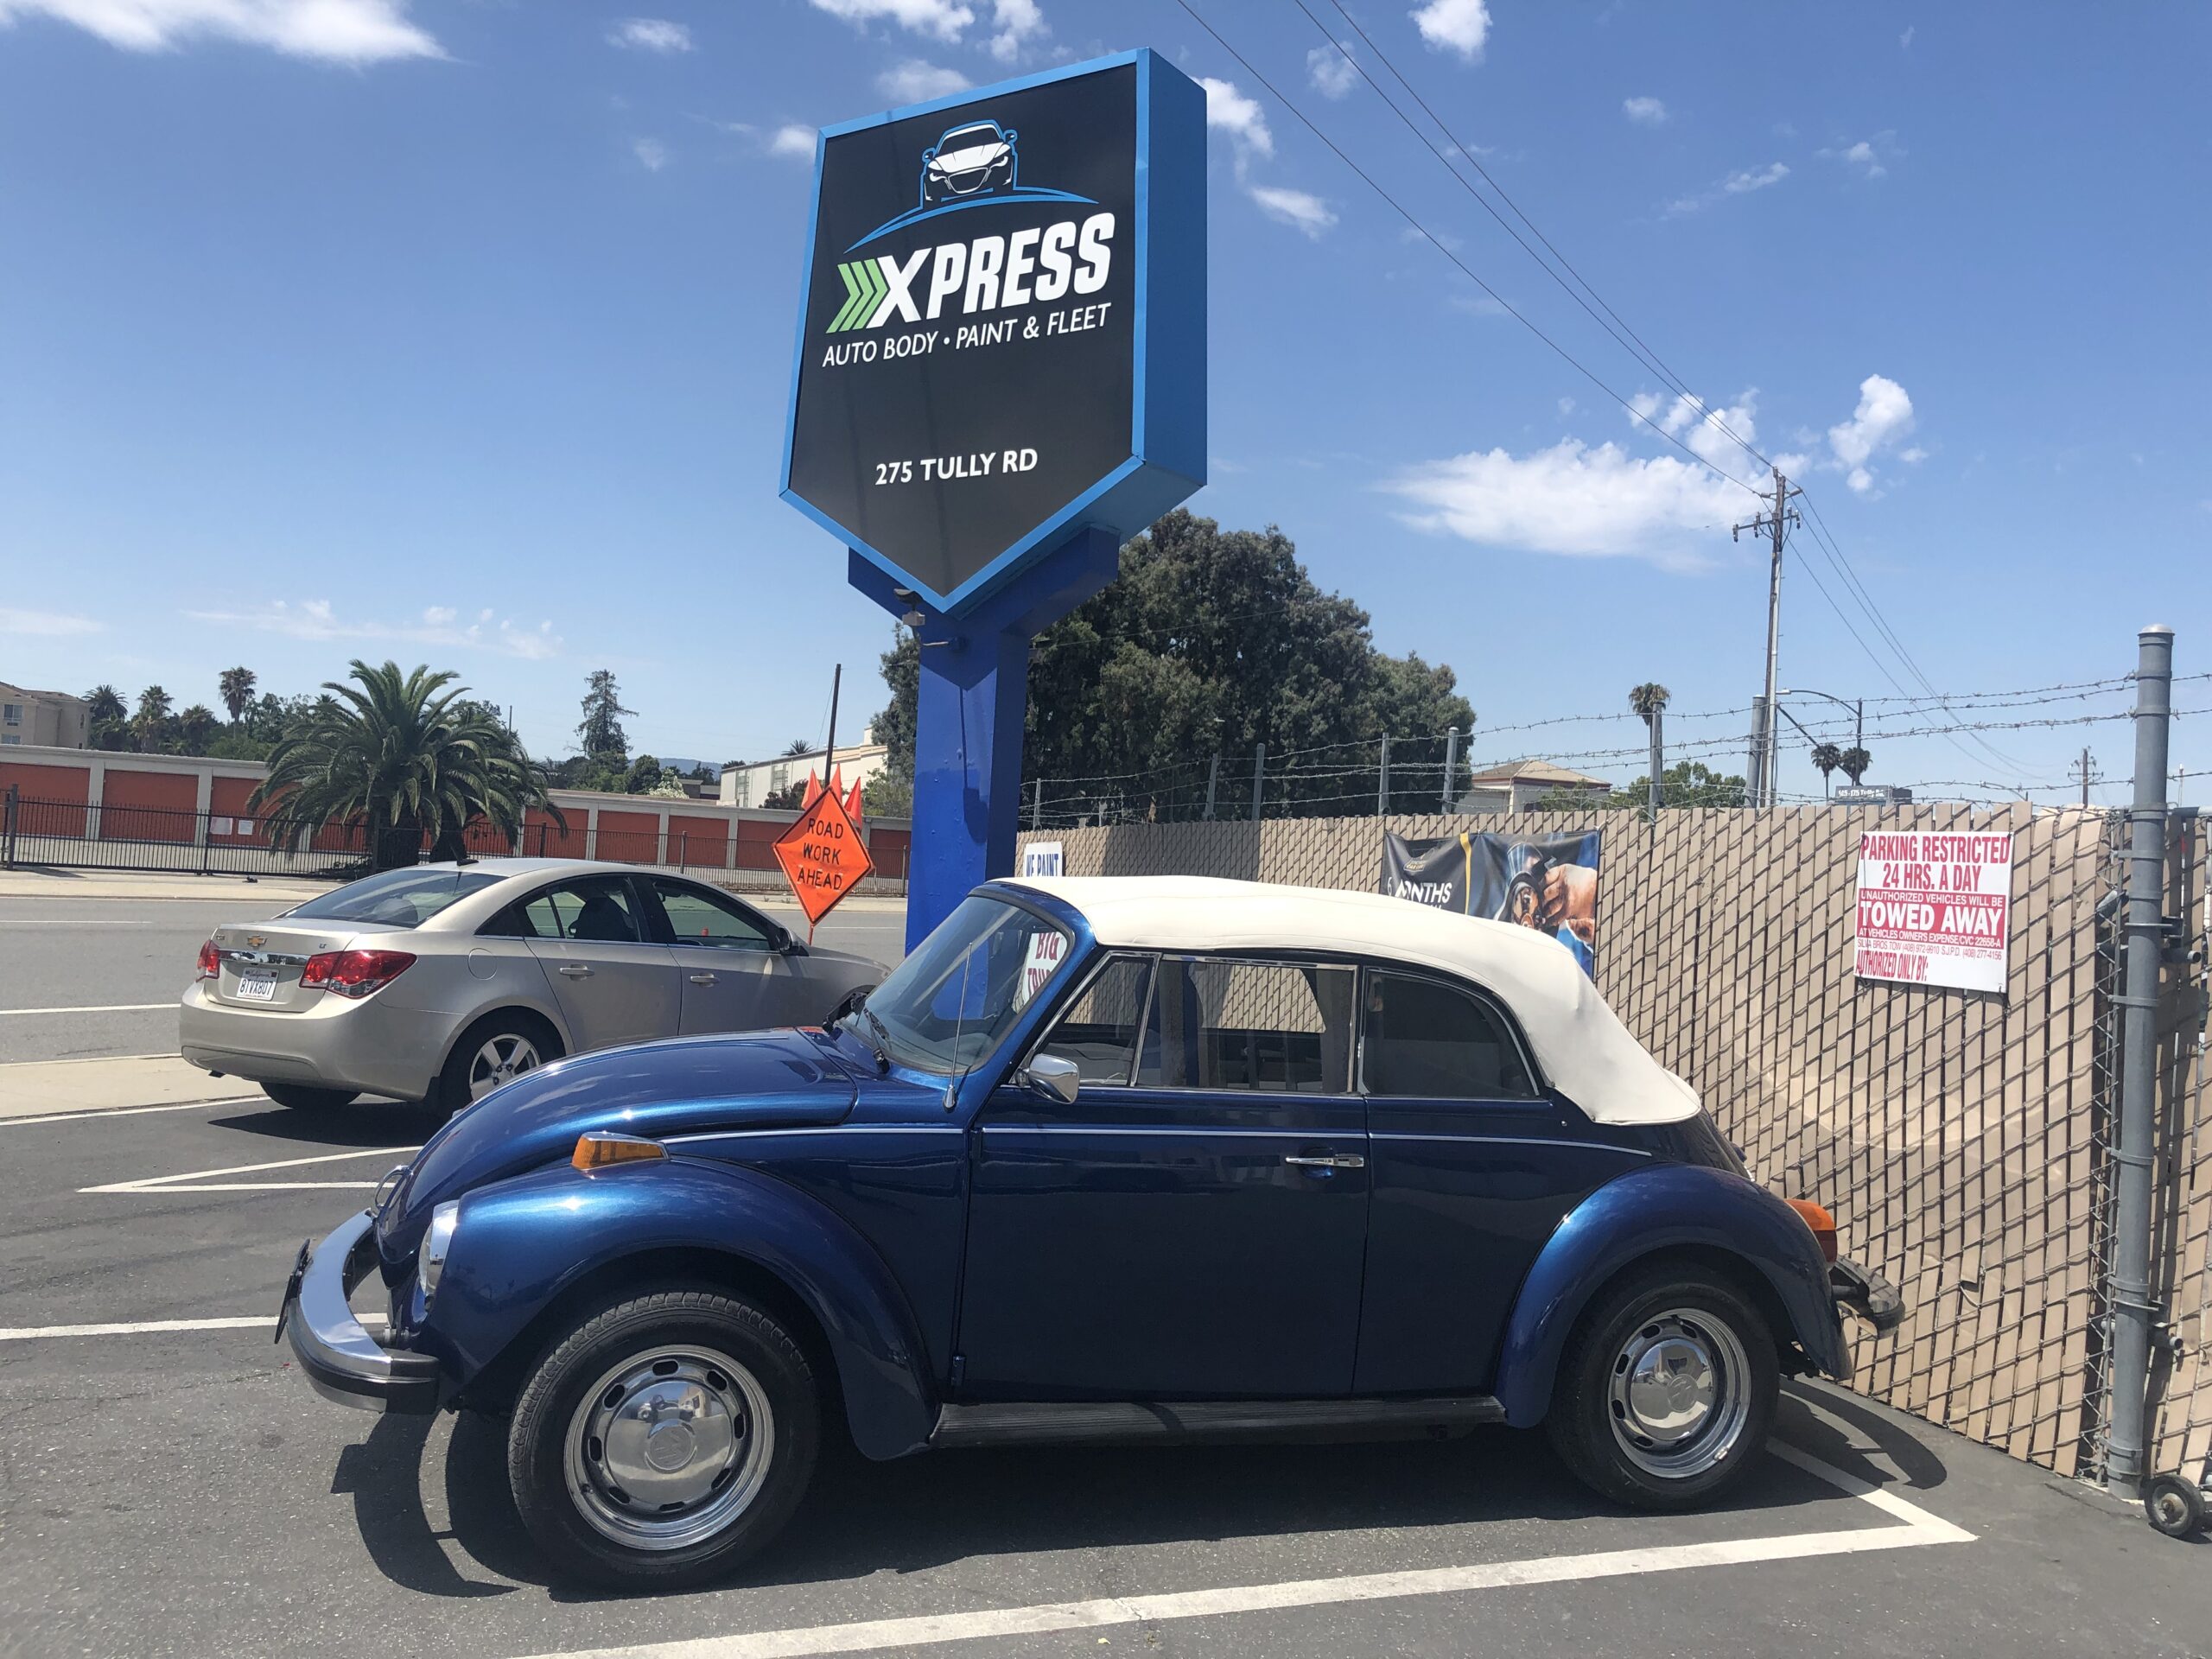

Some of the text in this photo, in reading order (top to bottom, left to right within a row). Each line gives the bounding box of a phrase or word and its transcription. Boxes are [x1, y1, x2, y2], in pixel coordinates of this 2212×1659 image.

[866, 213, 1115, 329] XPRESS
[822, 302, 1111, 367] AUTO BODY PAINT & FLEET
[875, 448, 1038, 486] 275 TULLY RD
[807, 818, 843, 839] ROAD
[804, 842, 841, 865] WORK
[1860, 835, 2010, 864] PARKING RESTRICTED
[798, 868, 842, 890] AHEAD
[1026, 854, 1058, 877] WE PAINT
[1883, 862, 1981, 892] 24 HRS. A DAY
[1387, 876, 1392, 897] 6
[1860, 890, 2003, 907] UNAUTHORIZED VEHICLES WILL BE
[1860, 900, 2003, 936] TOWED AWAY
[1036, 932, 1059, 960] BIG
[1859, 927, 1867, 937] AT
[1868, 928, 1898, 939] VEHICLES
[1929, 933, 1959, 944] EXPENSE
[1960, 936, 1974, 946] CVC
[1856, 950, 1897, 978] AUTHORIZED
[1897, 953, 1917, 980] ONLY
